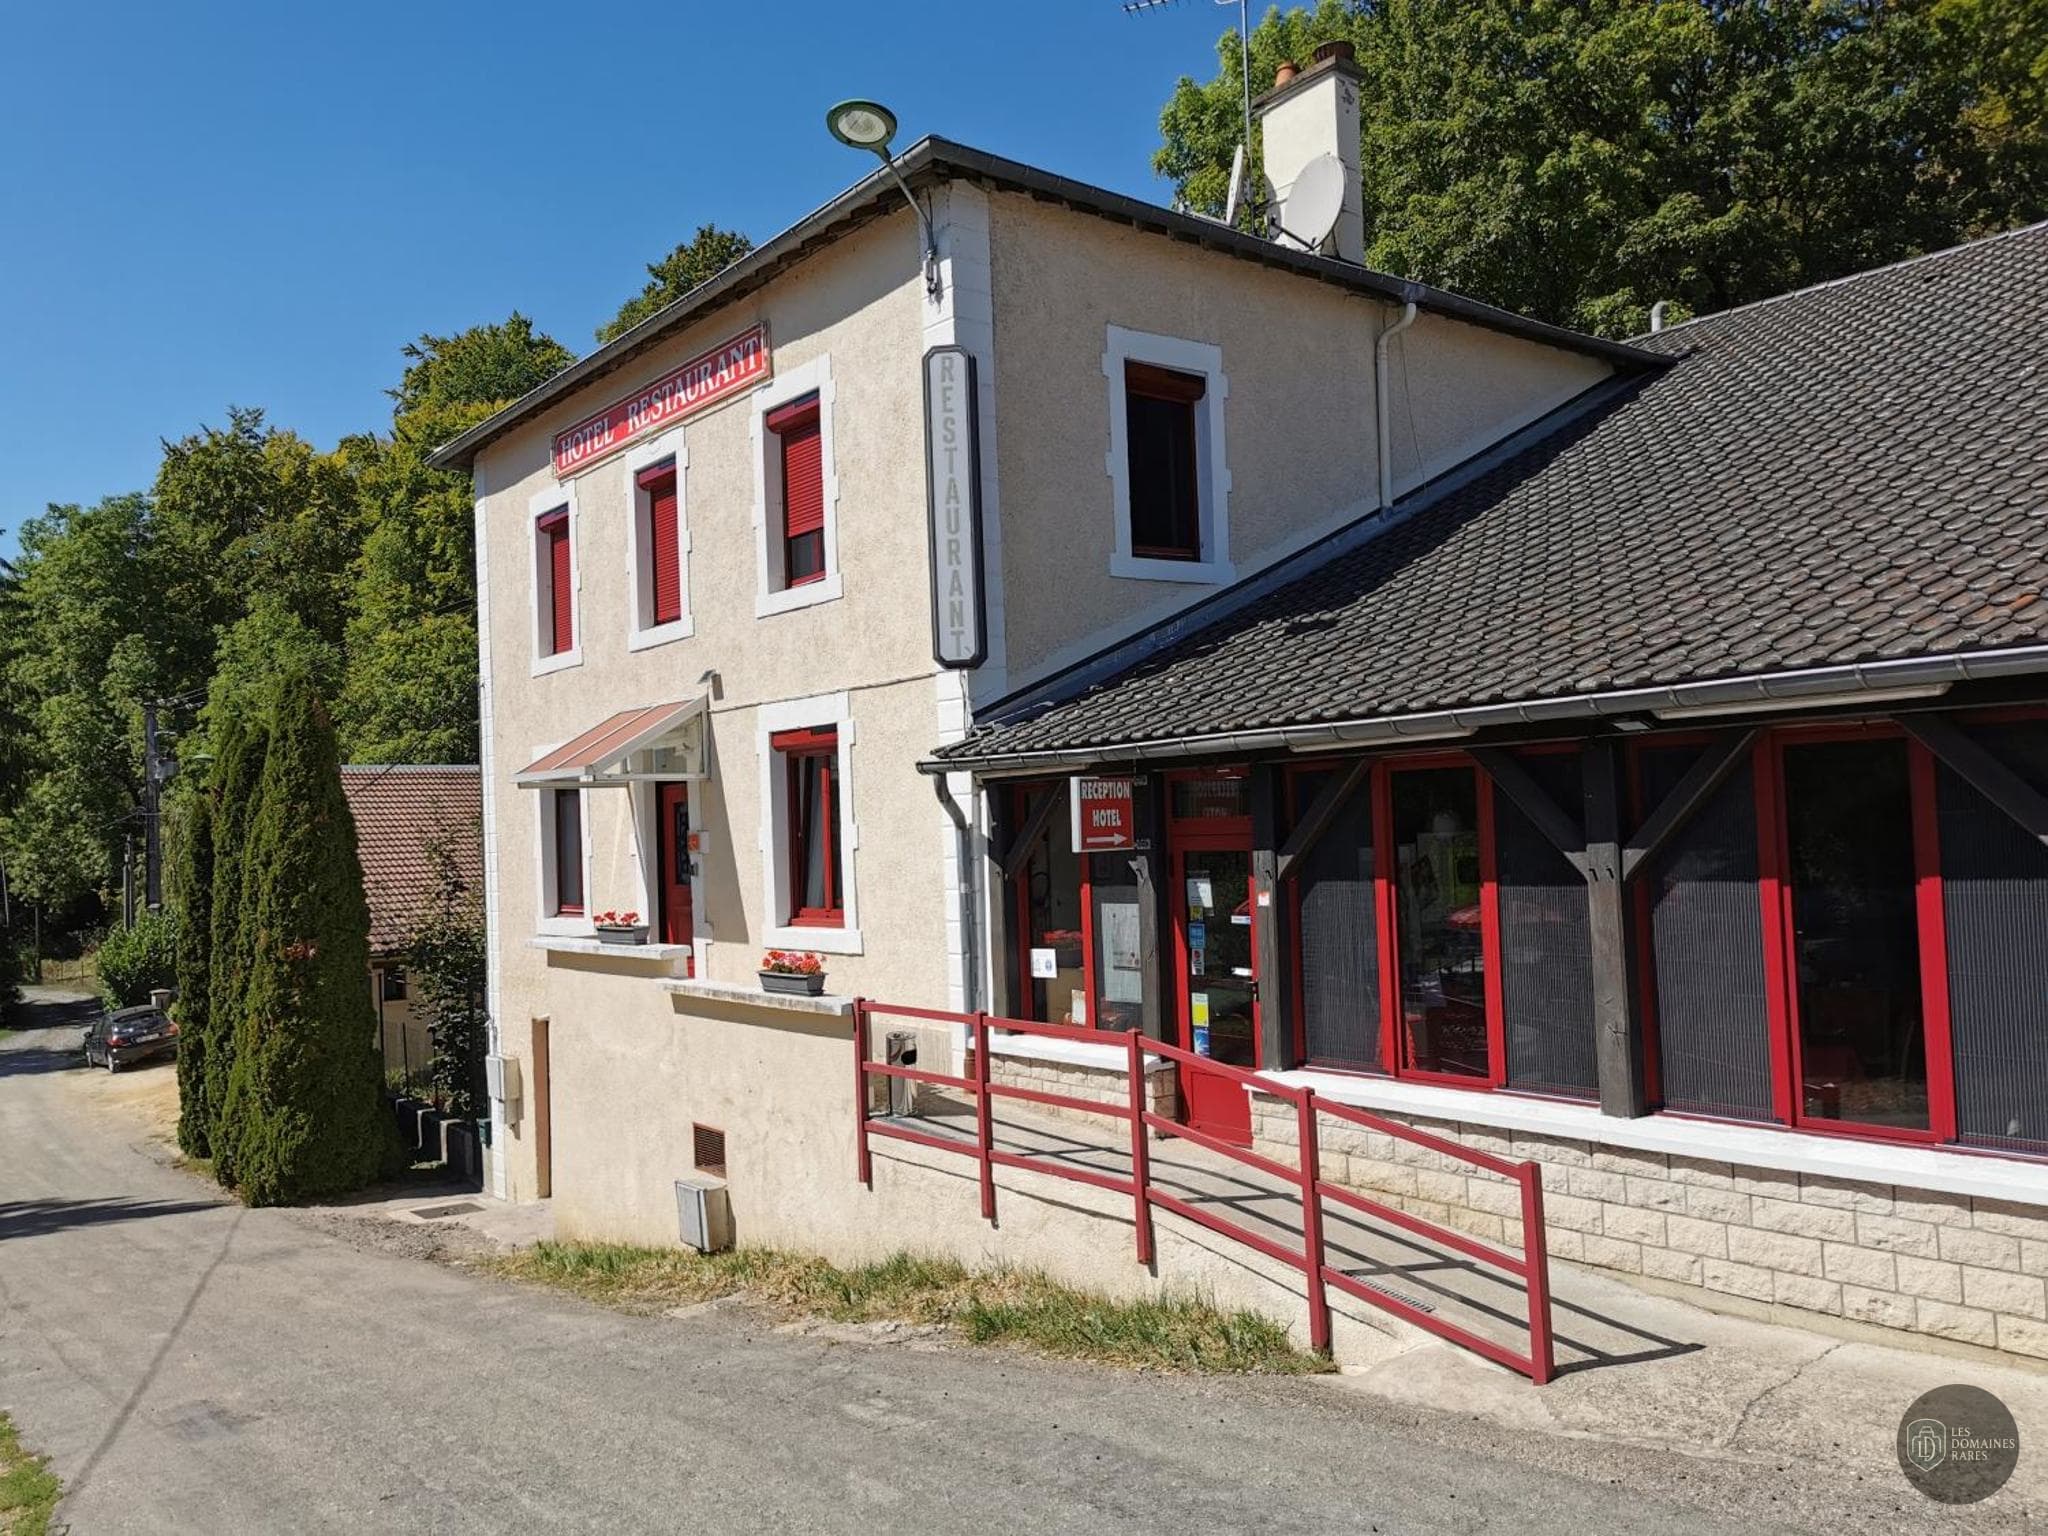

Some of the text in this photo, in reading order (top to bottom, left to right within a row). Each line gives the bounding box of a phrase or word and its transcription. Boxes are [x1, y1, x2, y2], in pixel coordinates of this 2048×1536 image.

[561, 337, 759, 466] HOTEL RESTAURANT
[940, 355, 965, 656] RESTAURANT
[1081, 781, 1131, 799] RECEPTION
[1092, 809, 1122, 827] HOTEL
